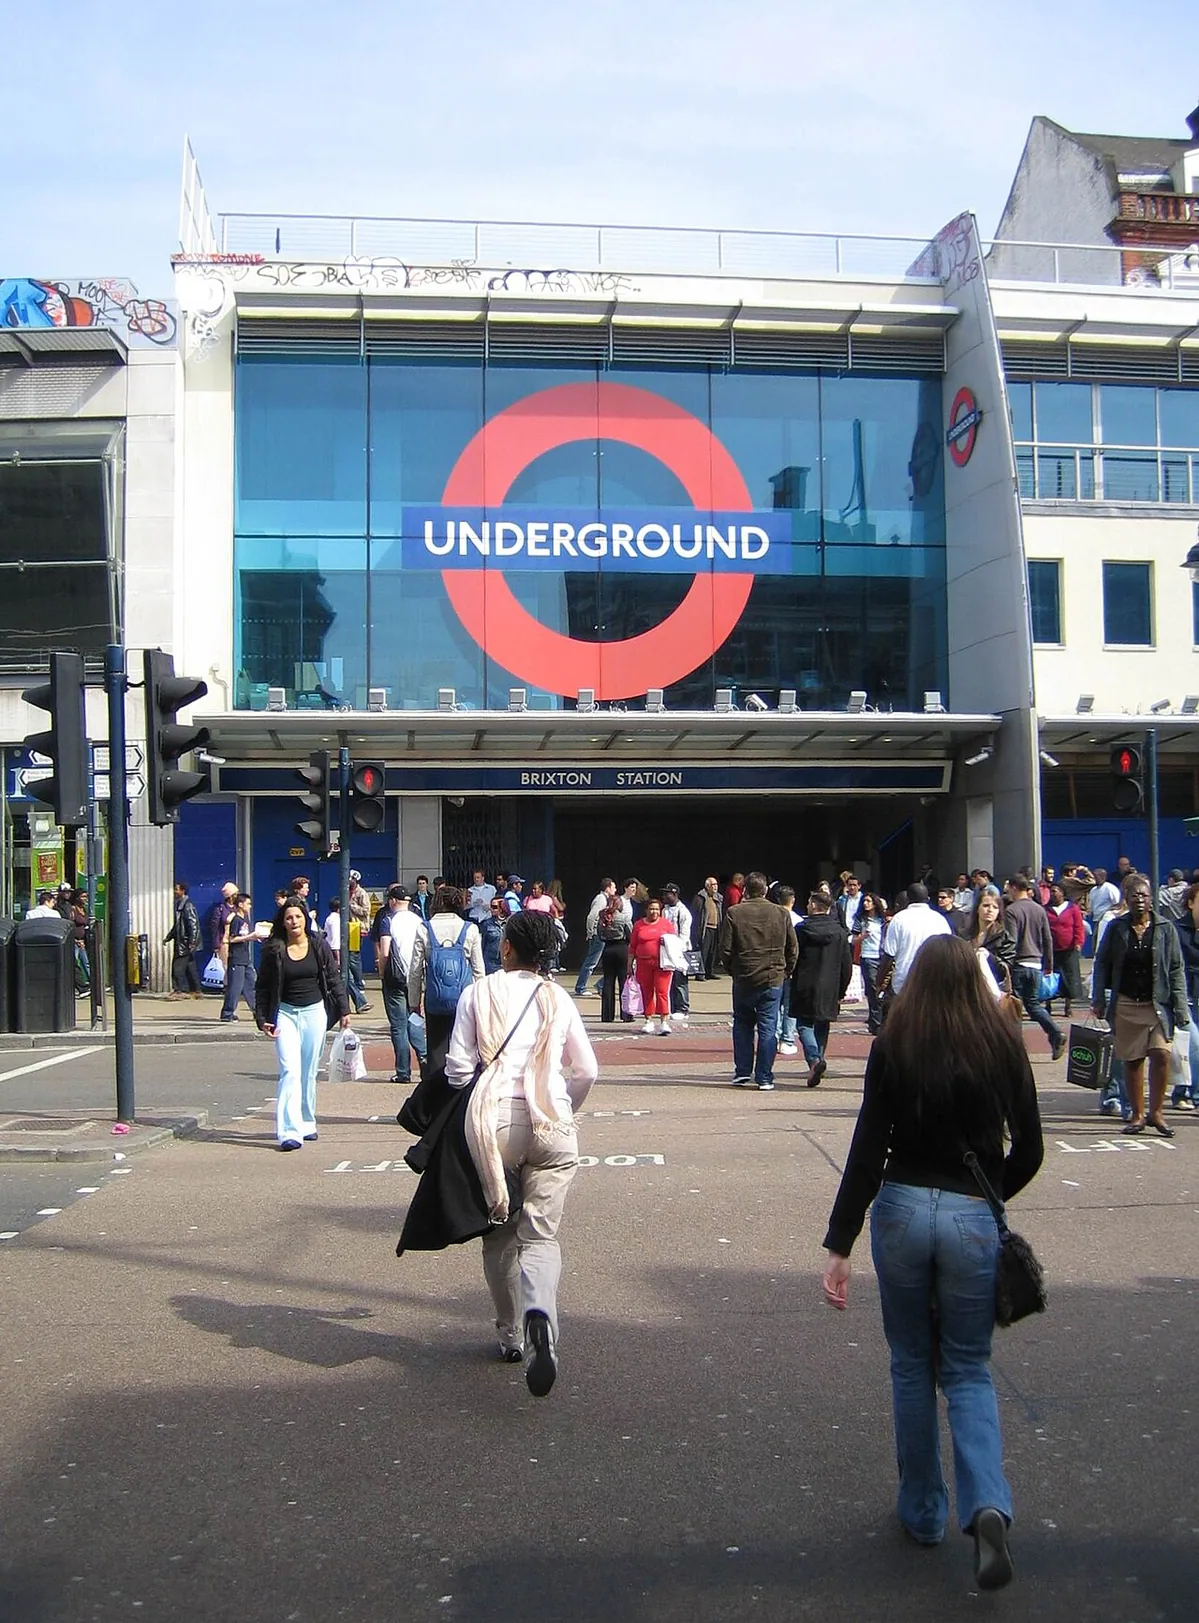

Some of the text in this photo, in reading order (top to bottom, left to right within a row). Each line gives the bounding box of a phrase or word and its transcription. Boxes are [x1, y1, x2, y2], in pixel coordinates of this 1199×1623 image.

[424, 520, 770, 560] UNDERGROUND
[520, 772, 683, 785] BRIXTON STATION
[1072, 1049, 1093, 1064] schuh
[1055, 1138, 1176, 1154] LEFT
[578, 1154, 665, 1167] LOO
